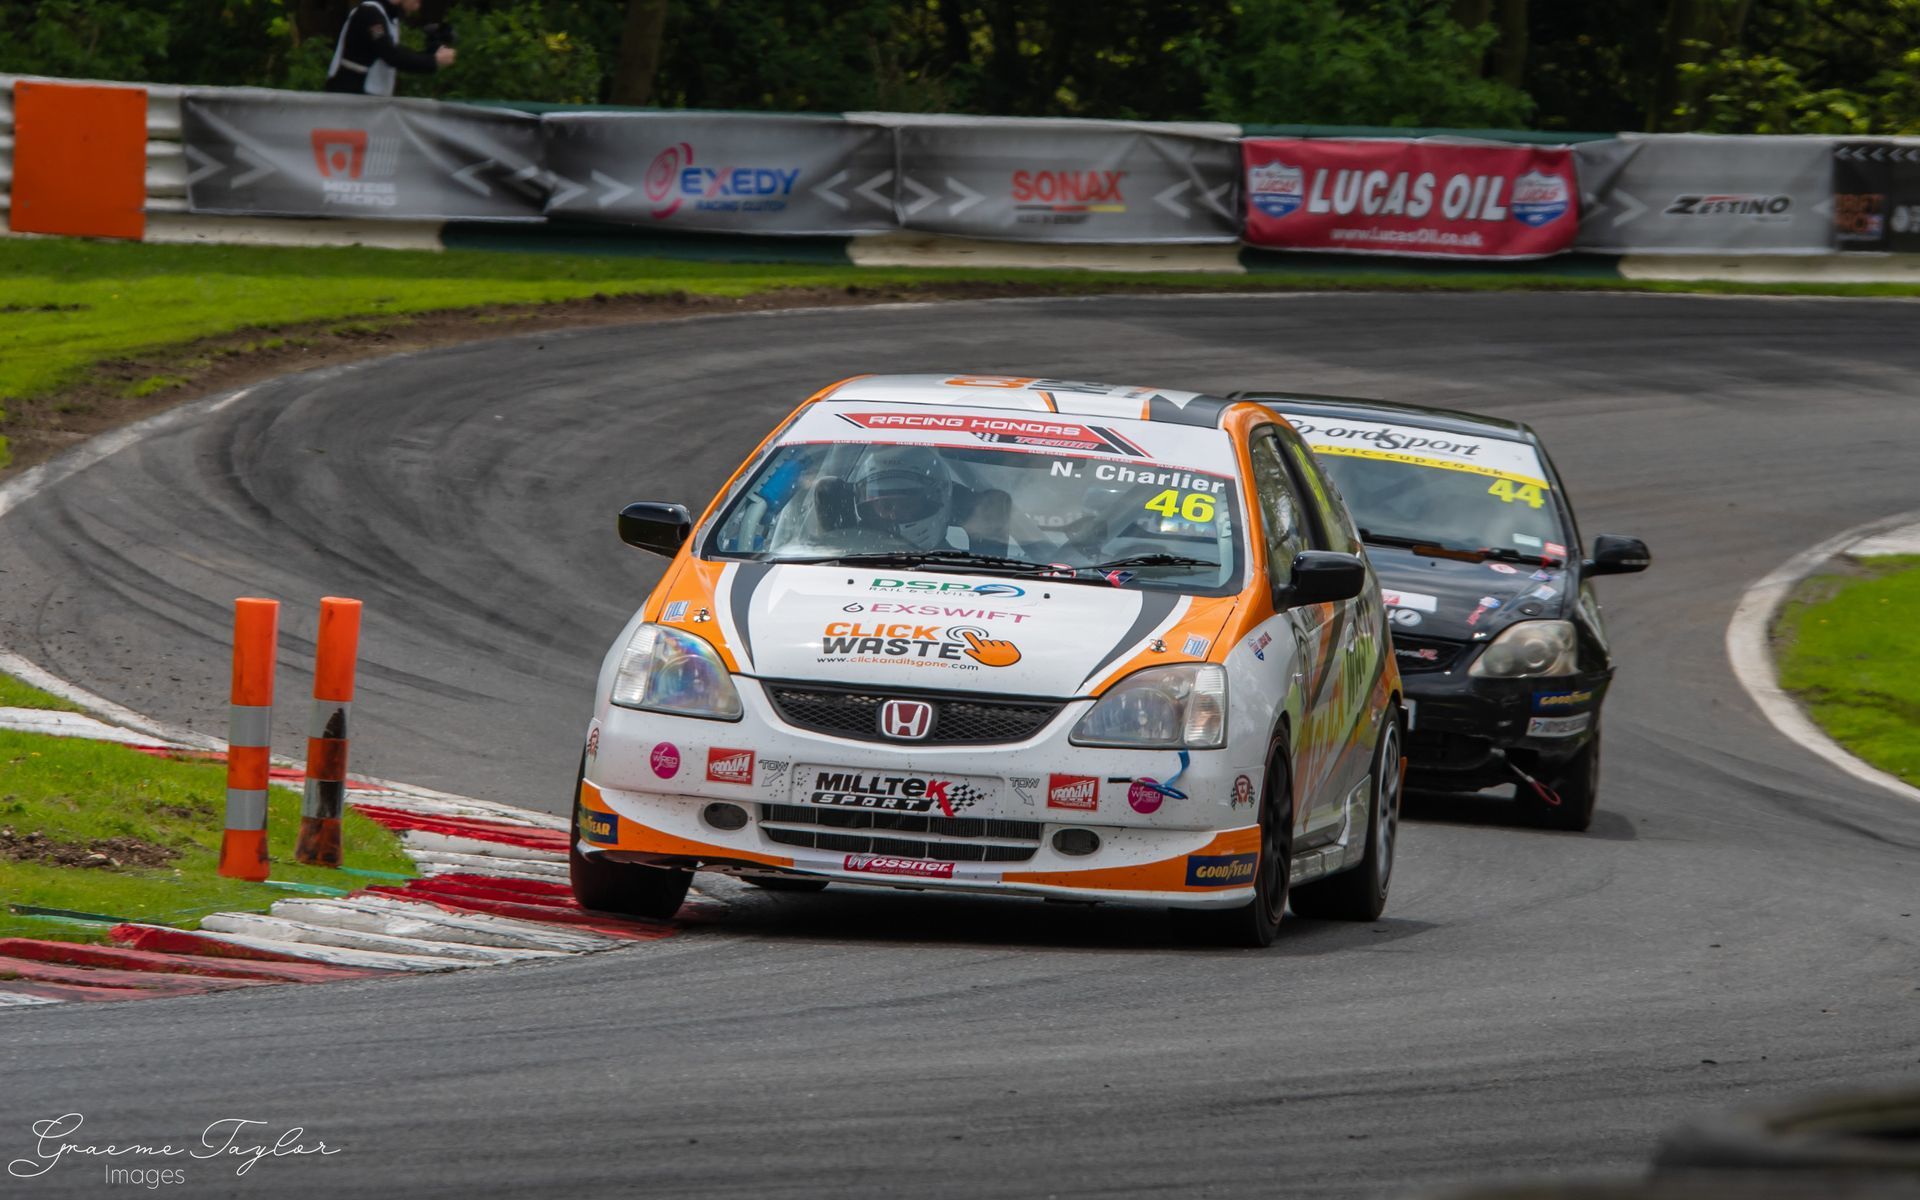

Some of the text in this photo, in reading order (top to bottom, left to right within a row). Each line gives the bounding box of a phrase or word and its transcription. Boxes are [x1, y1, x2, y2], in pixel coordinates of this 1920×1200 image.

[680, 167, 799, 197] EXEDY
[1012, 169, 1125, 202] SONAX
[1308, 168, 1507, 221] LUCAS OIL
[1664, 195, 1791, 215] ZESTINO
[868, 415, 1081, 437] RACING HONDAS
[1050, 461, 1225, 493] N. Charlier
[1488, 478, 1545, 509] 44
[1144, 489, 1217, 523] 46
[871, 578, 972, 592] DSP
[870, 603, 1031, 624] EXSWIFT
[824, 622, 943, 640] CLICK
[822, 637, 966, 660] WASTE
[817, 656, 979, 671] www.clickanditsgone.com
[759, 759, 789, 772] TOW
[1010, 777, 1040, 789] TOW
[819, 794, 920, 810] SPORT
[1196, 858, 1253, 882] GOODYEAR
